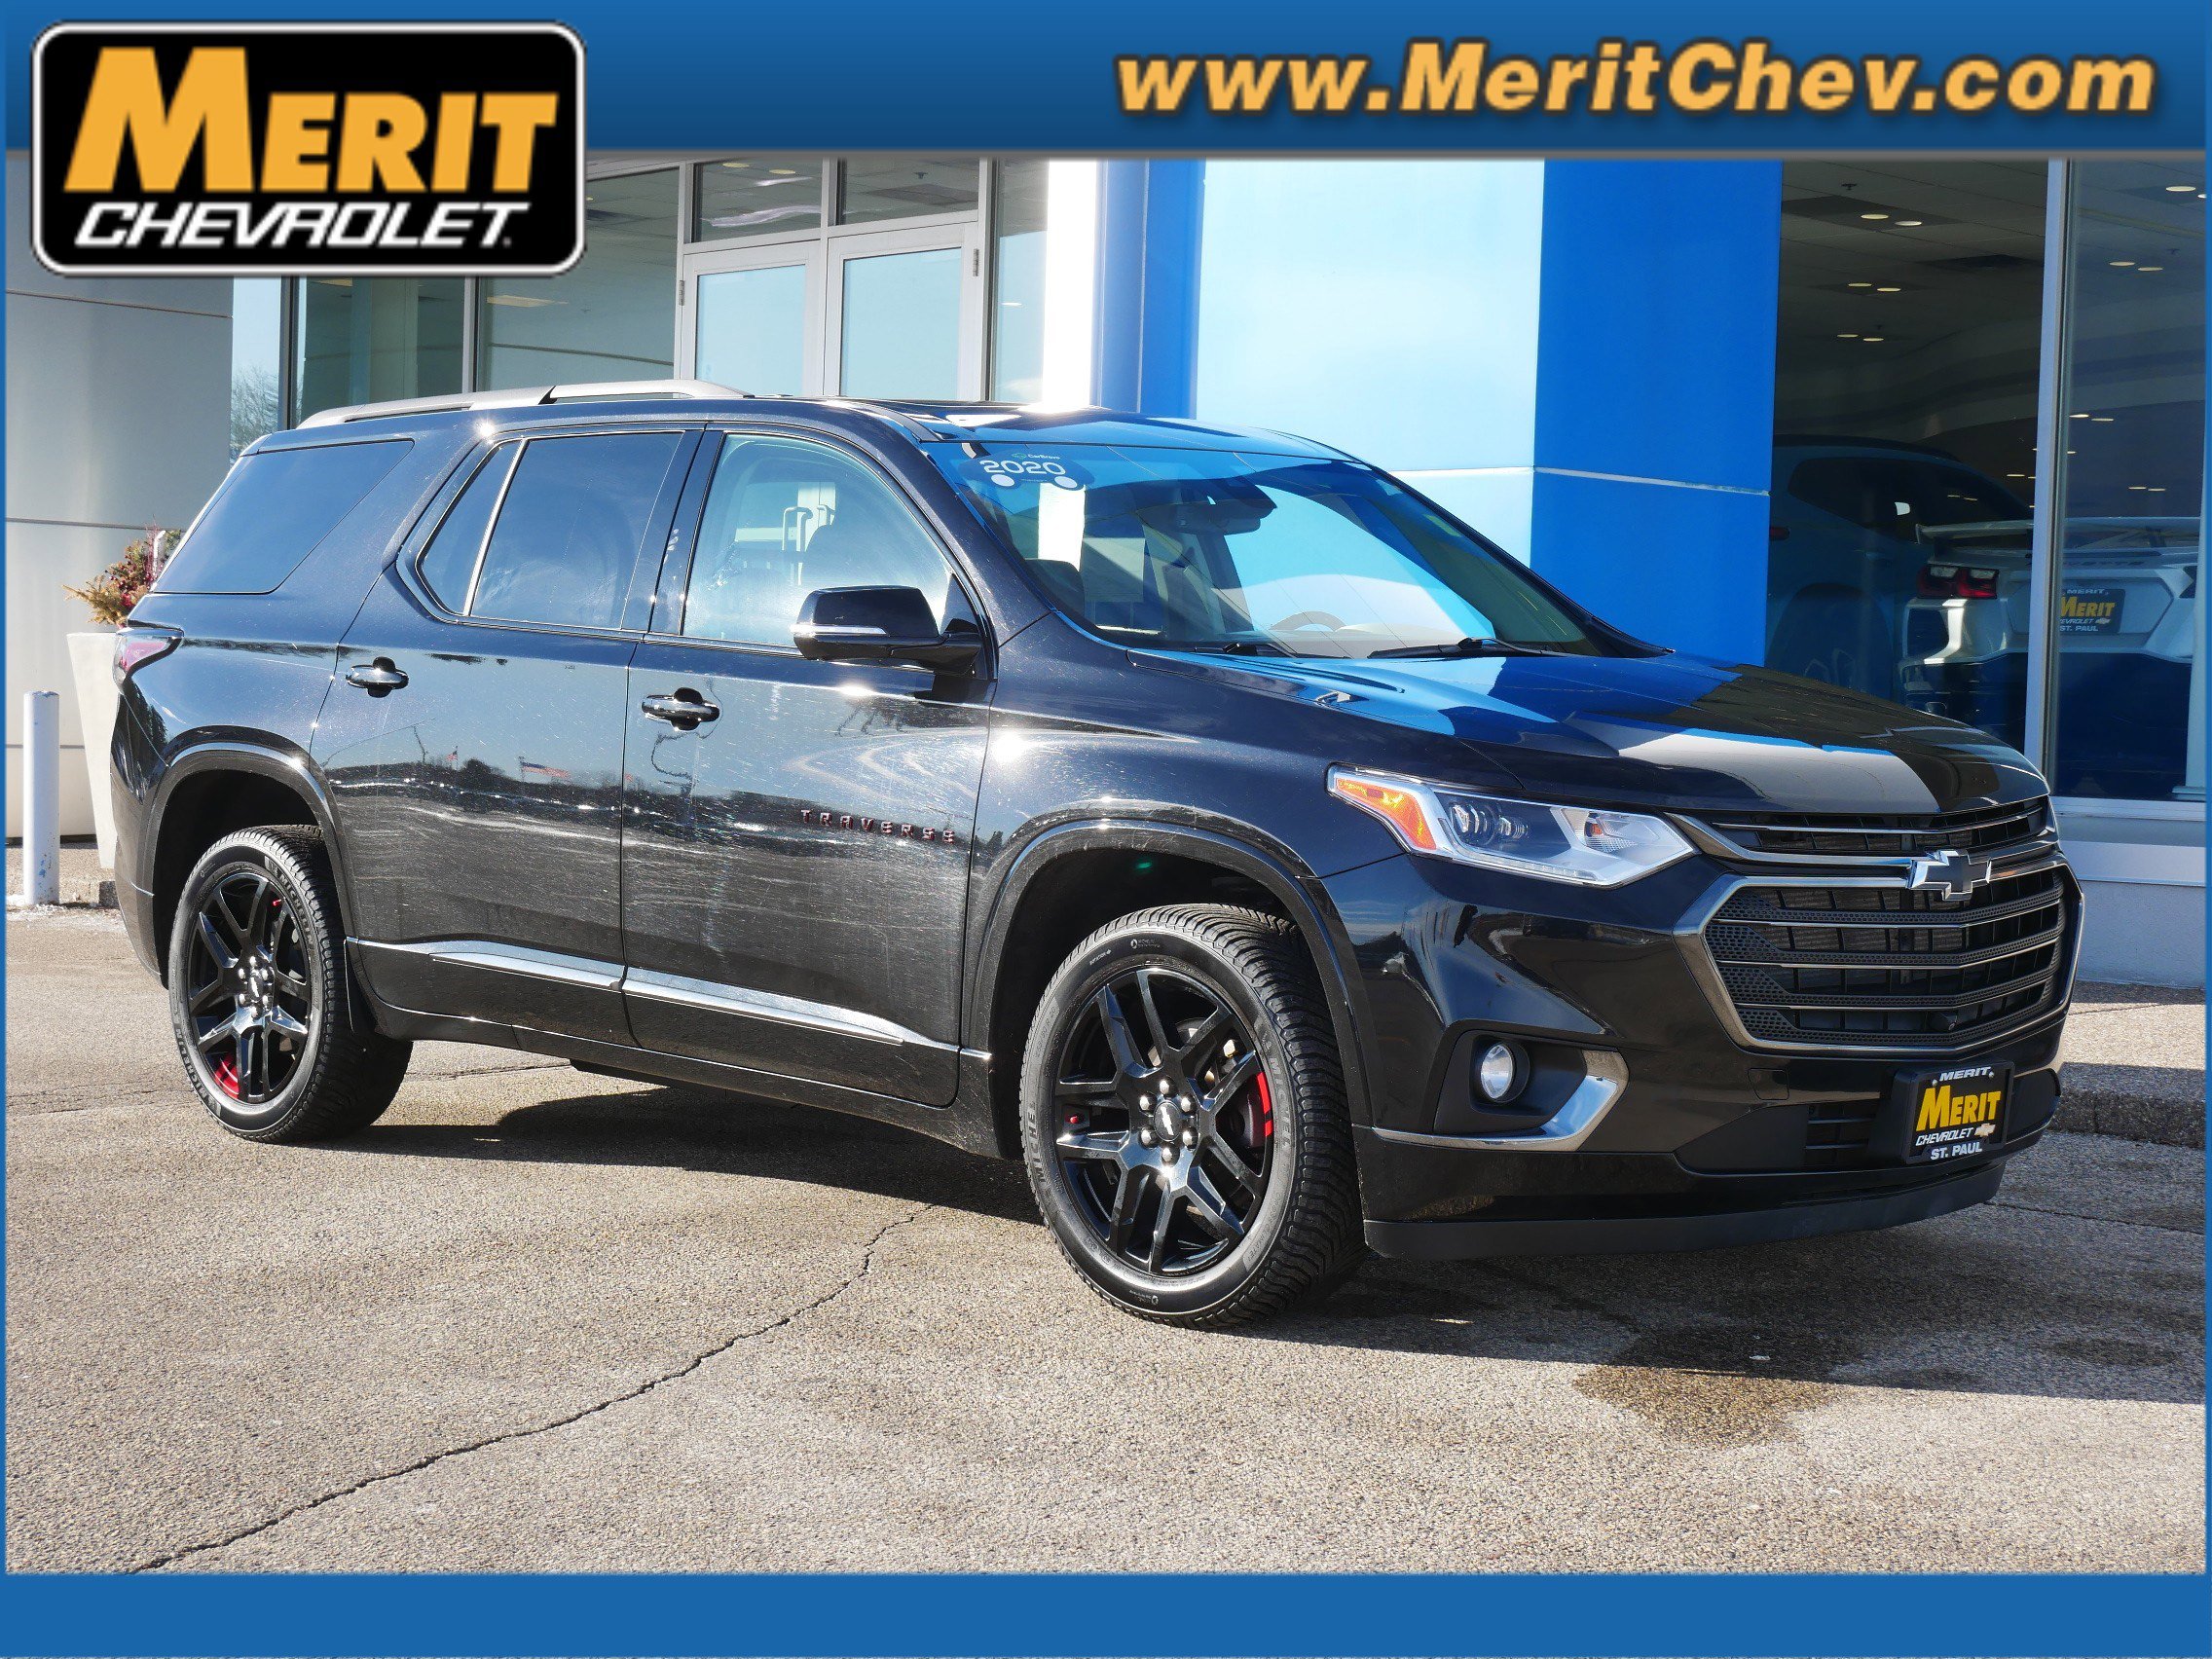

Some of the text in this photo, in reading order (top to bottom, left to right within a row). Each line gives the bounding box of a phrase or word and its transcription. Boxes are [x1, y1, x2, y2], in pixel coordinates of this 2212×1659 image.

[979, 460, 1066, 475] 2020
[801, 809, 955, 844] TRAVERSE
[1939, 1066, 1991, 1082] MERIT
[1916, 1085, 2002, 1131] MERIT
[1915, 1127, 1974, 1146] CHEVROLET
[1931, 1142, 1983, 1161] ST. PAUL
